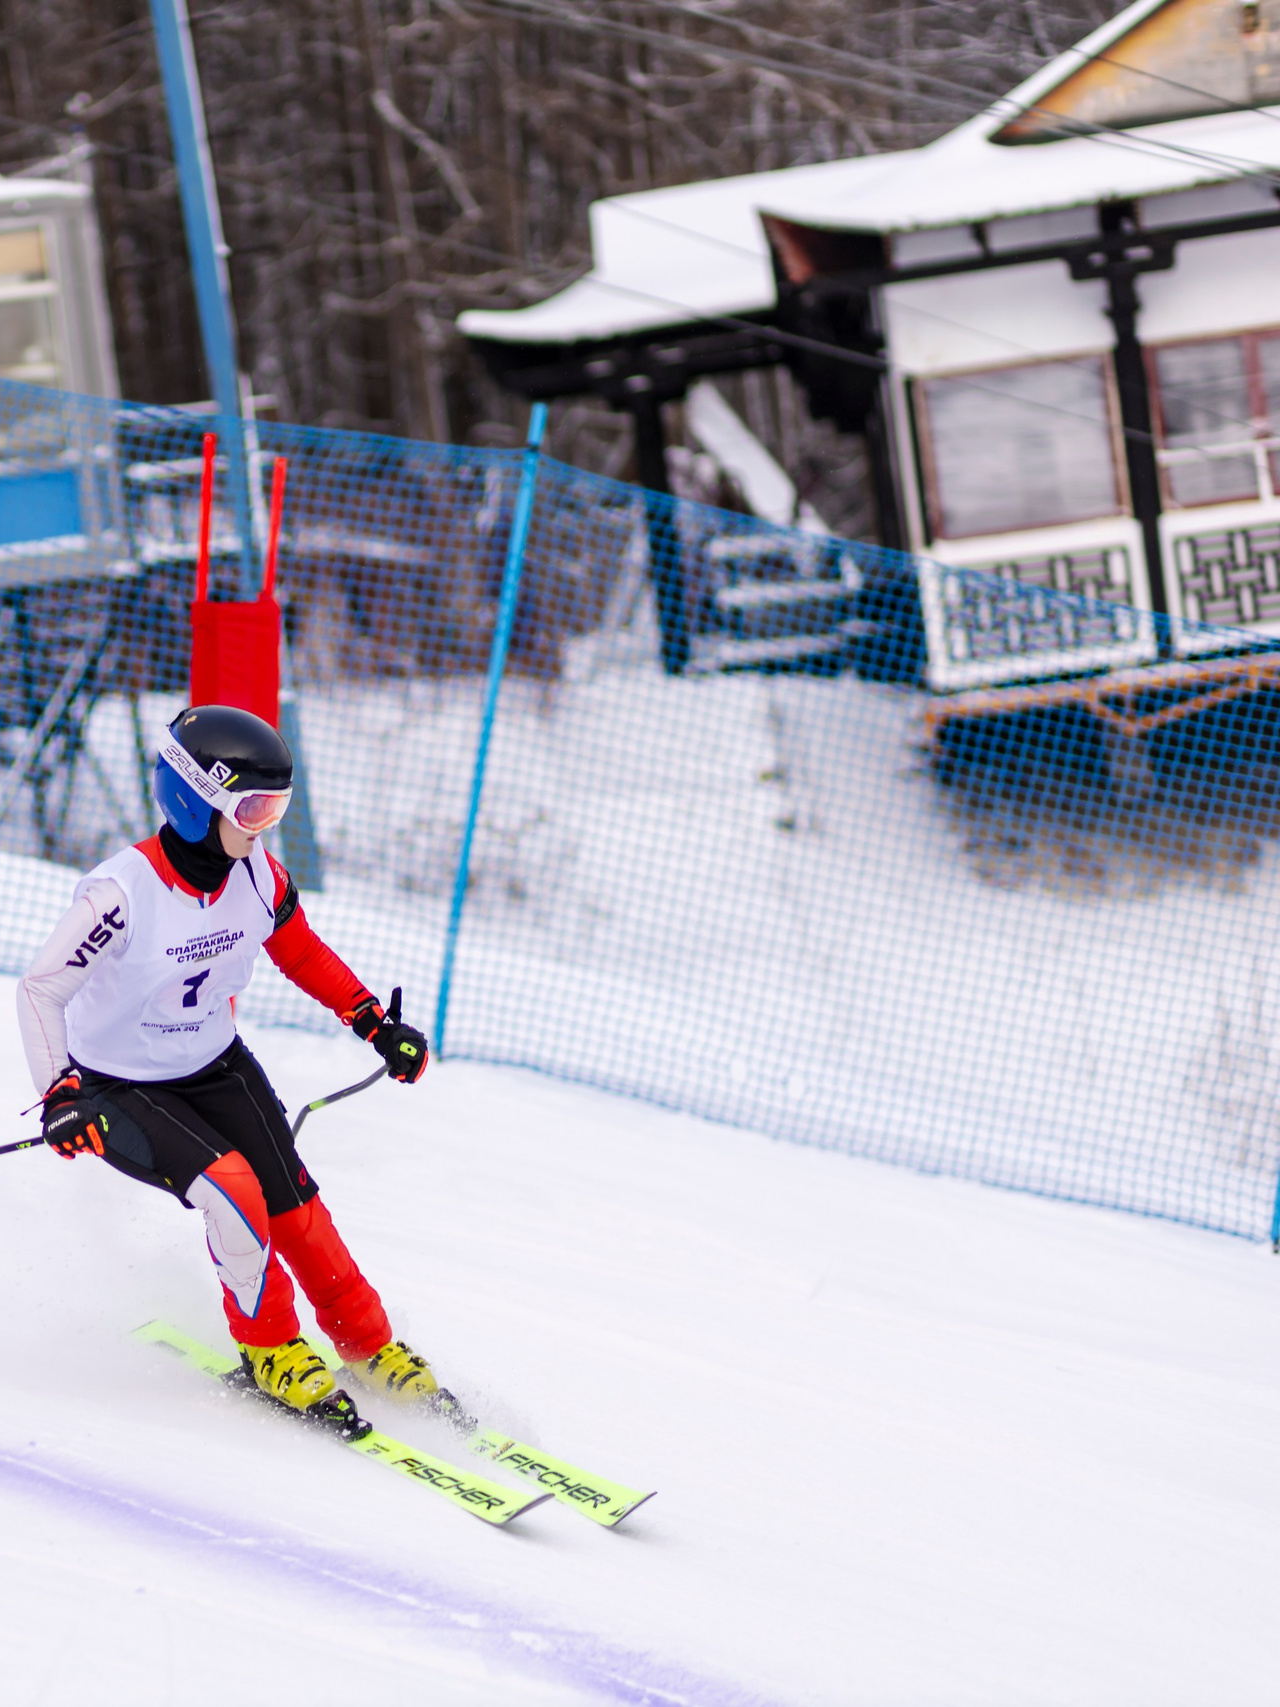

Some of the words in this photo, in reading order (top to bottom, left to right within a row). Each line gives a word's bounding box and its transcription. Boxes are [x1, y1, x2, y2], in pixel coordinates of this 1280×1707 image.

[164, 745, 219, 798] SALICE
[166, 930, 244, 956] СПАРТАКИАДА
[186, 934, 208, 944] ПЕРВАЯ
[177, 948, 212, 963] СТРАН
[214, 942, 236, 954] СНГ
[162, 1026, 181, 1034] УФА
[48, 1110, 78, 1132] reusch
[391, 1457, 506, 1510] FISCHER
[498, 1453, 611, 1509] FISCHER
